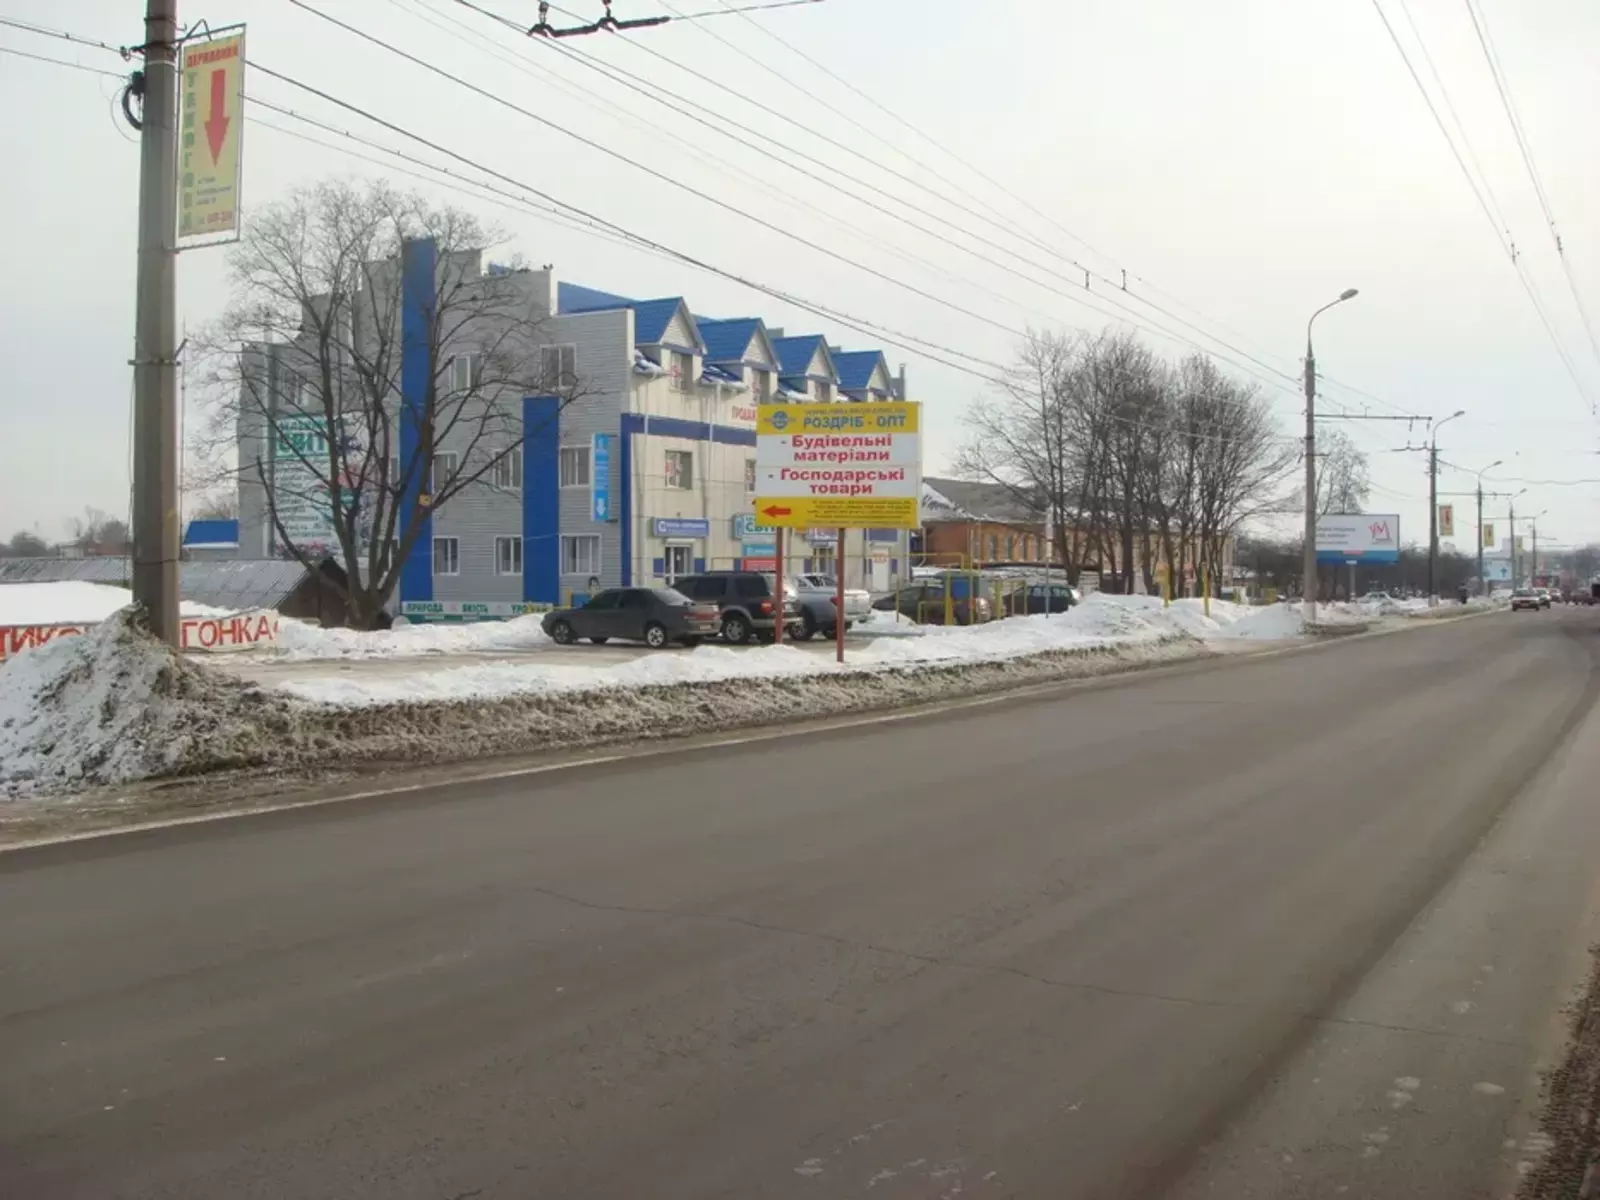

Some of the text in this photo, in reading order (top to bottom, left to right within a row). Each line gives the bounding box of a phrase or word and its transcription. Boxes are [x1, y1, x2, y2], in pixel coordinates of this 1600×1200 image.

[803, 415, 864, 430] РОЗДРІБ
[877, 414, 906, 428] ОПТ
[791, 433, 892, 449] Будівельні
[793, 448, 890, 463] матеріали
[780, 467, 905, 485] Господарські
[810, 482, 873, 497] товари
